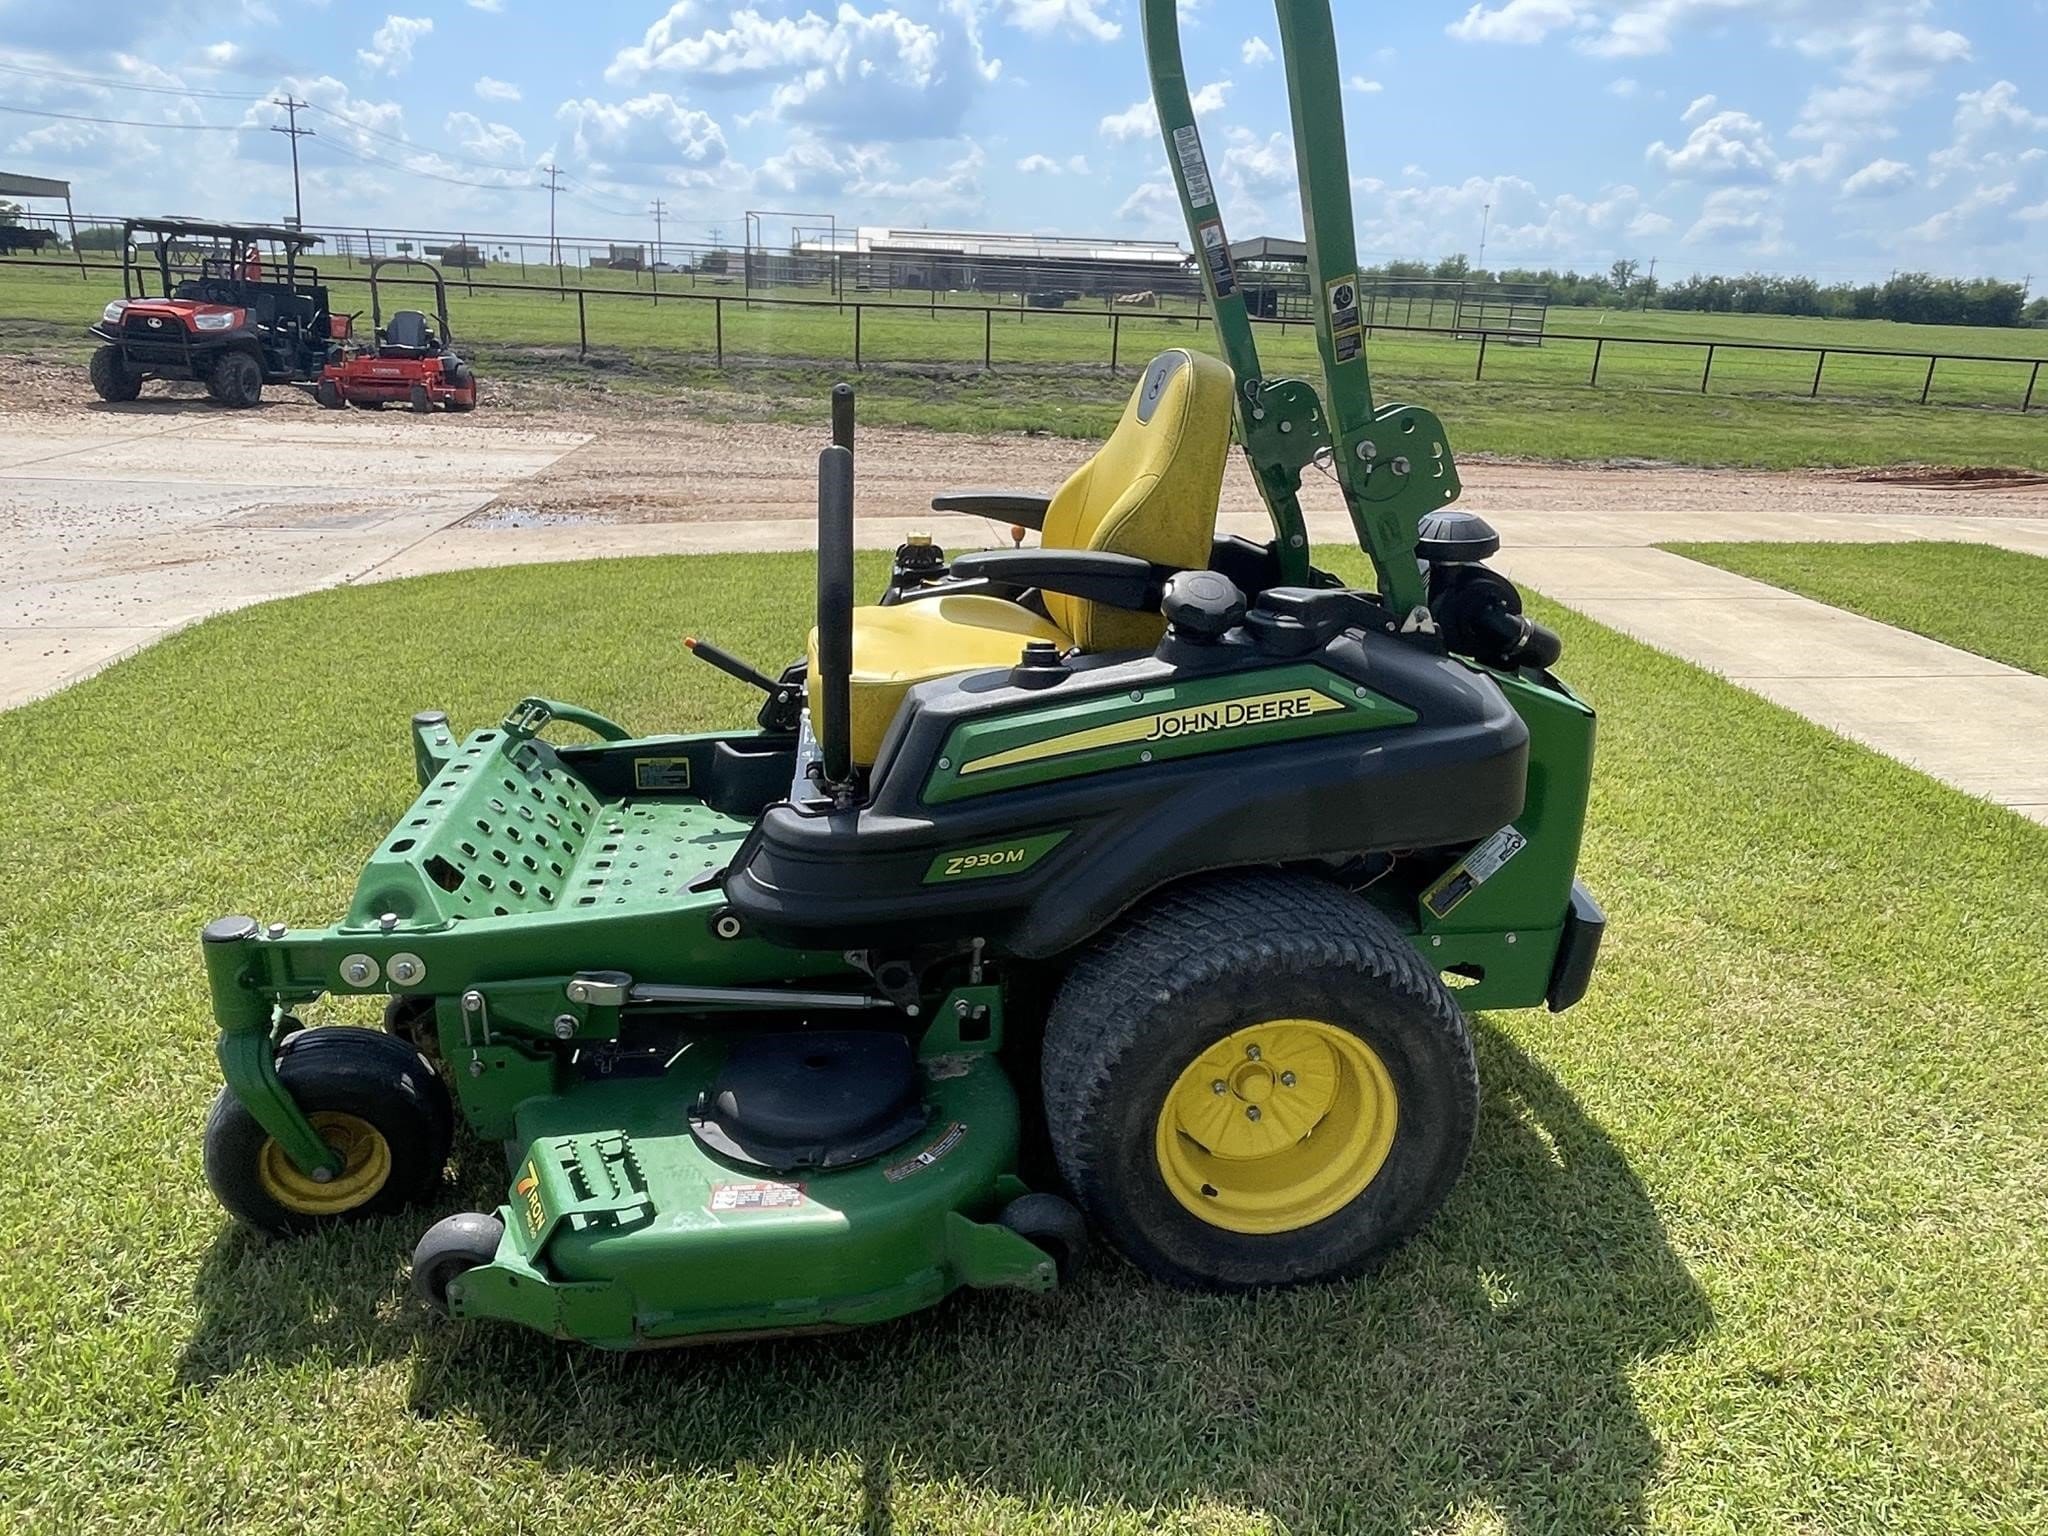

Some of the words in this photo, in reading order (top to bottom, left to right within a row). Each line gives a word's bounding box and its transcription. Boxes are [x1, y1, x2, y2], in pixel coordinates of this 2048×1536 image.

[1146, 710, 1219, 740] JOHN
[1225, 696, 1312, 726] DEERE
[944, 848, 1025, 875] Z930M
[517, 1160, 540, 1196] 7
[527, 1186, 546, 1231] IRON
